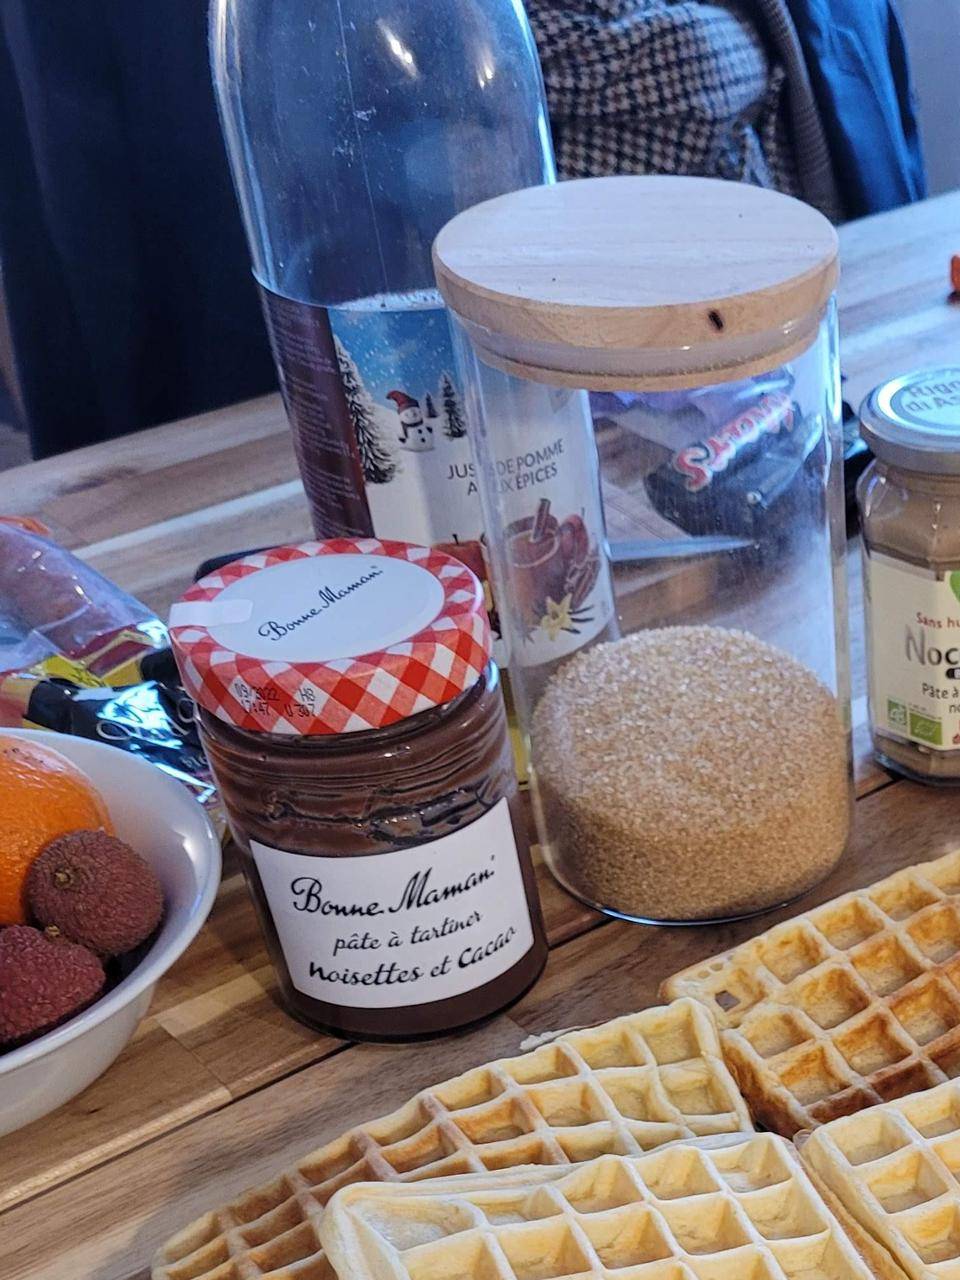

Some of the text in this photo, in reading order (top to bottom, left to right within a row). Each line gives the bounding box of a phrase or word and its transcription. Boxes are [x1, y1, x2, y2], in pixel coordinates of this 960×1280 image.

[905, 401, 932, 412] di
[447, 438, 564, 480] JUS DE POMME
[257, 568, 384, 641] Bonne Maman
[916, 611, 943, 629] Sans
[921, 682, 949, 700] Pâte
[951, 687, 960, 698] à
[290, 866, 496, 917] Bonne Maman
[332, 909, 483, 957] pâte à tartiner
[308, 960, 425, 986] noisettes
[430, 957, 453, 978] et
